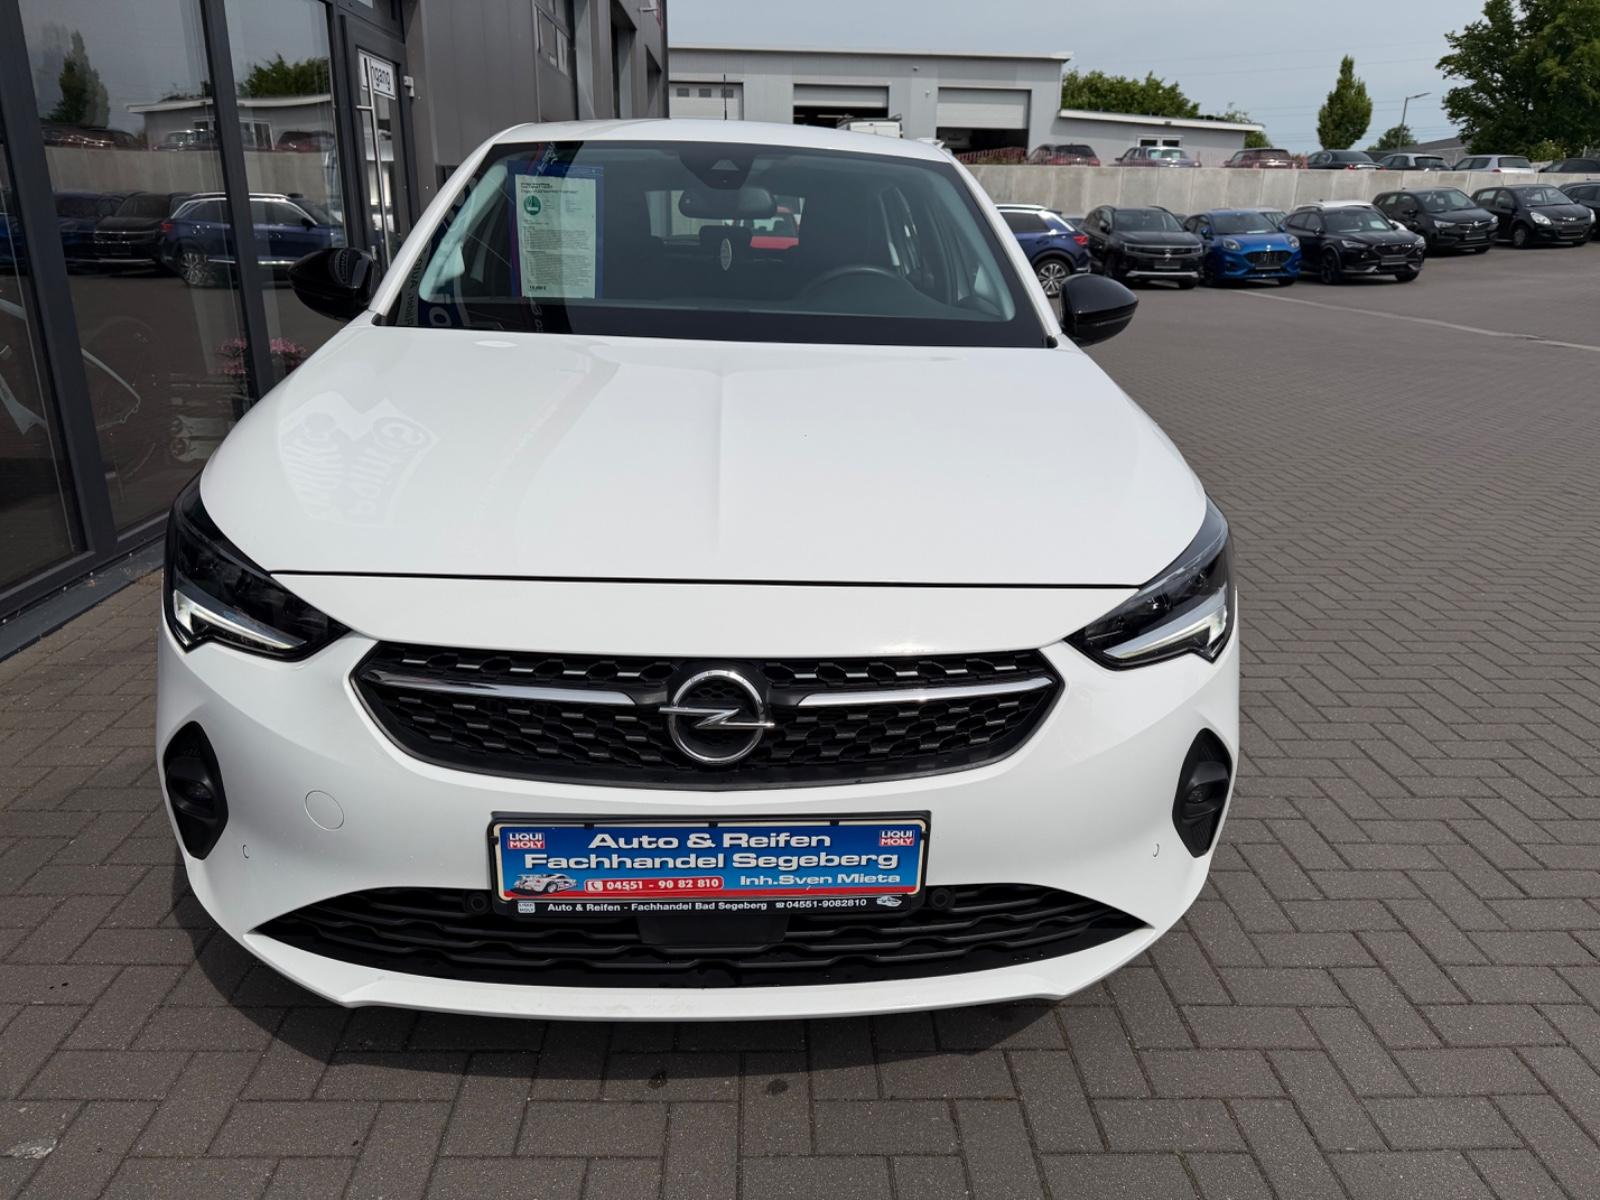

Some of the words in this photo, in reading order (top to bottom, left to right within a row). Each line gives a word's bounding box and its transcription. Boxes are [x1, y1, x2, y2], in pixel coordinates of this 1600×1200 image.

[509, 833, 543, 841] LIQUI
[880, 830, 913, 838] LIQUI
[509, 841, 544, 849] MOLY
[588, 832, 679, 849] Auto
[687, 832, 716, 848] &
[723, 831, 831, 848] Reifen
[880, 838, 914, 846] MOLY
[524, 853, 724, 870] Fachhandel
[732, 852, 899, 870] Segeberg
[837, 873, 901, 884] Mieta
[606, 881, 643, 890] 04551
[658, 880, 674, 889] 90
[678, 880, 693, 888] 82
[697, 879, 719, 888] 810
[547, 903, 573, 912] Auto
[575, 903, 584, 912] &
[586, 903, 621, 912] Reifen
[631, 902, 692, 911] Fachhandel
[695, 902, 716, 911] Bad
[718, 901, 767, 911] Segeberg
